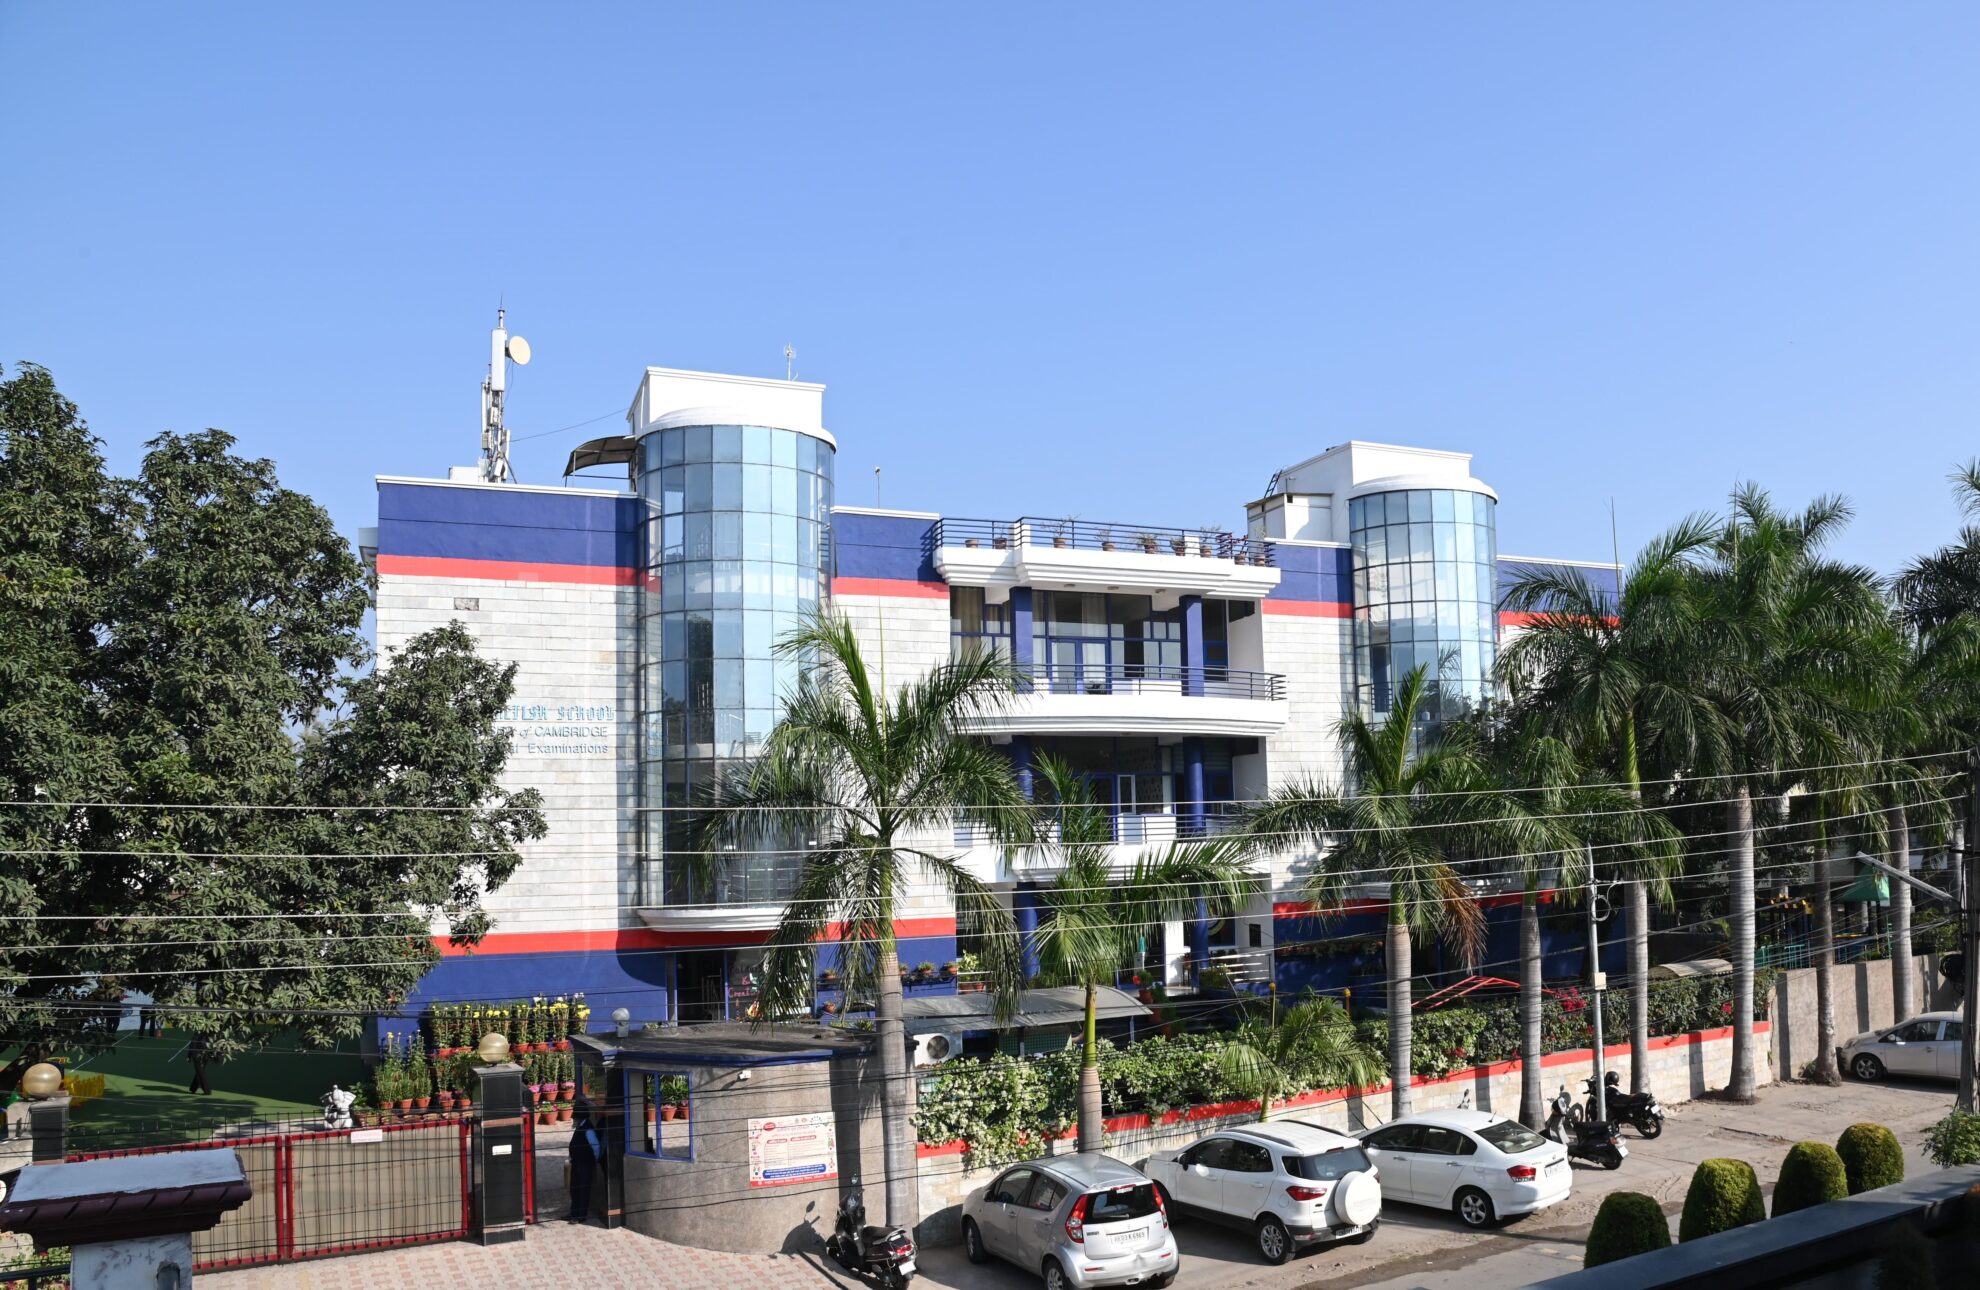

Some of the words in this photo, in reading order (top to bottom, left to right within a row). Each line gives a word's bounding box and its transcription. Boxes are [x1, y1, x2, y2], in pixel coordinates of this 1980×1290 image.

[496, 704, 548, 721] ITISH
[556, 703, 615, 721] SCHOOL
[534, 726, 609, 738] CAMBRIDGE
[527, 742, 609, 754] Examinations
